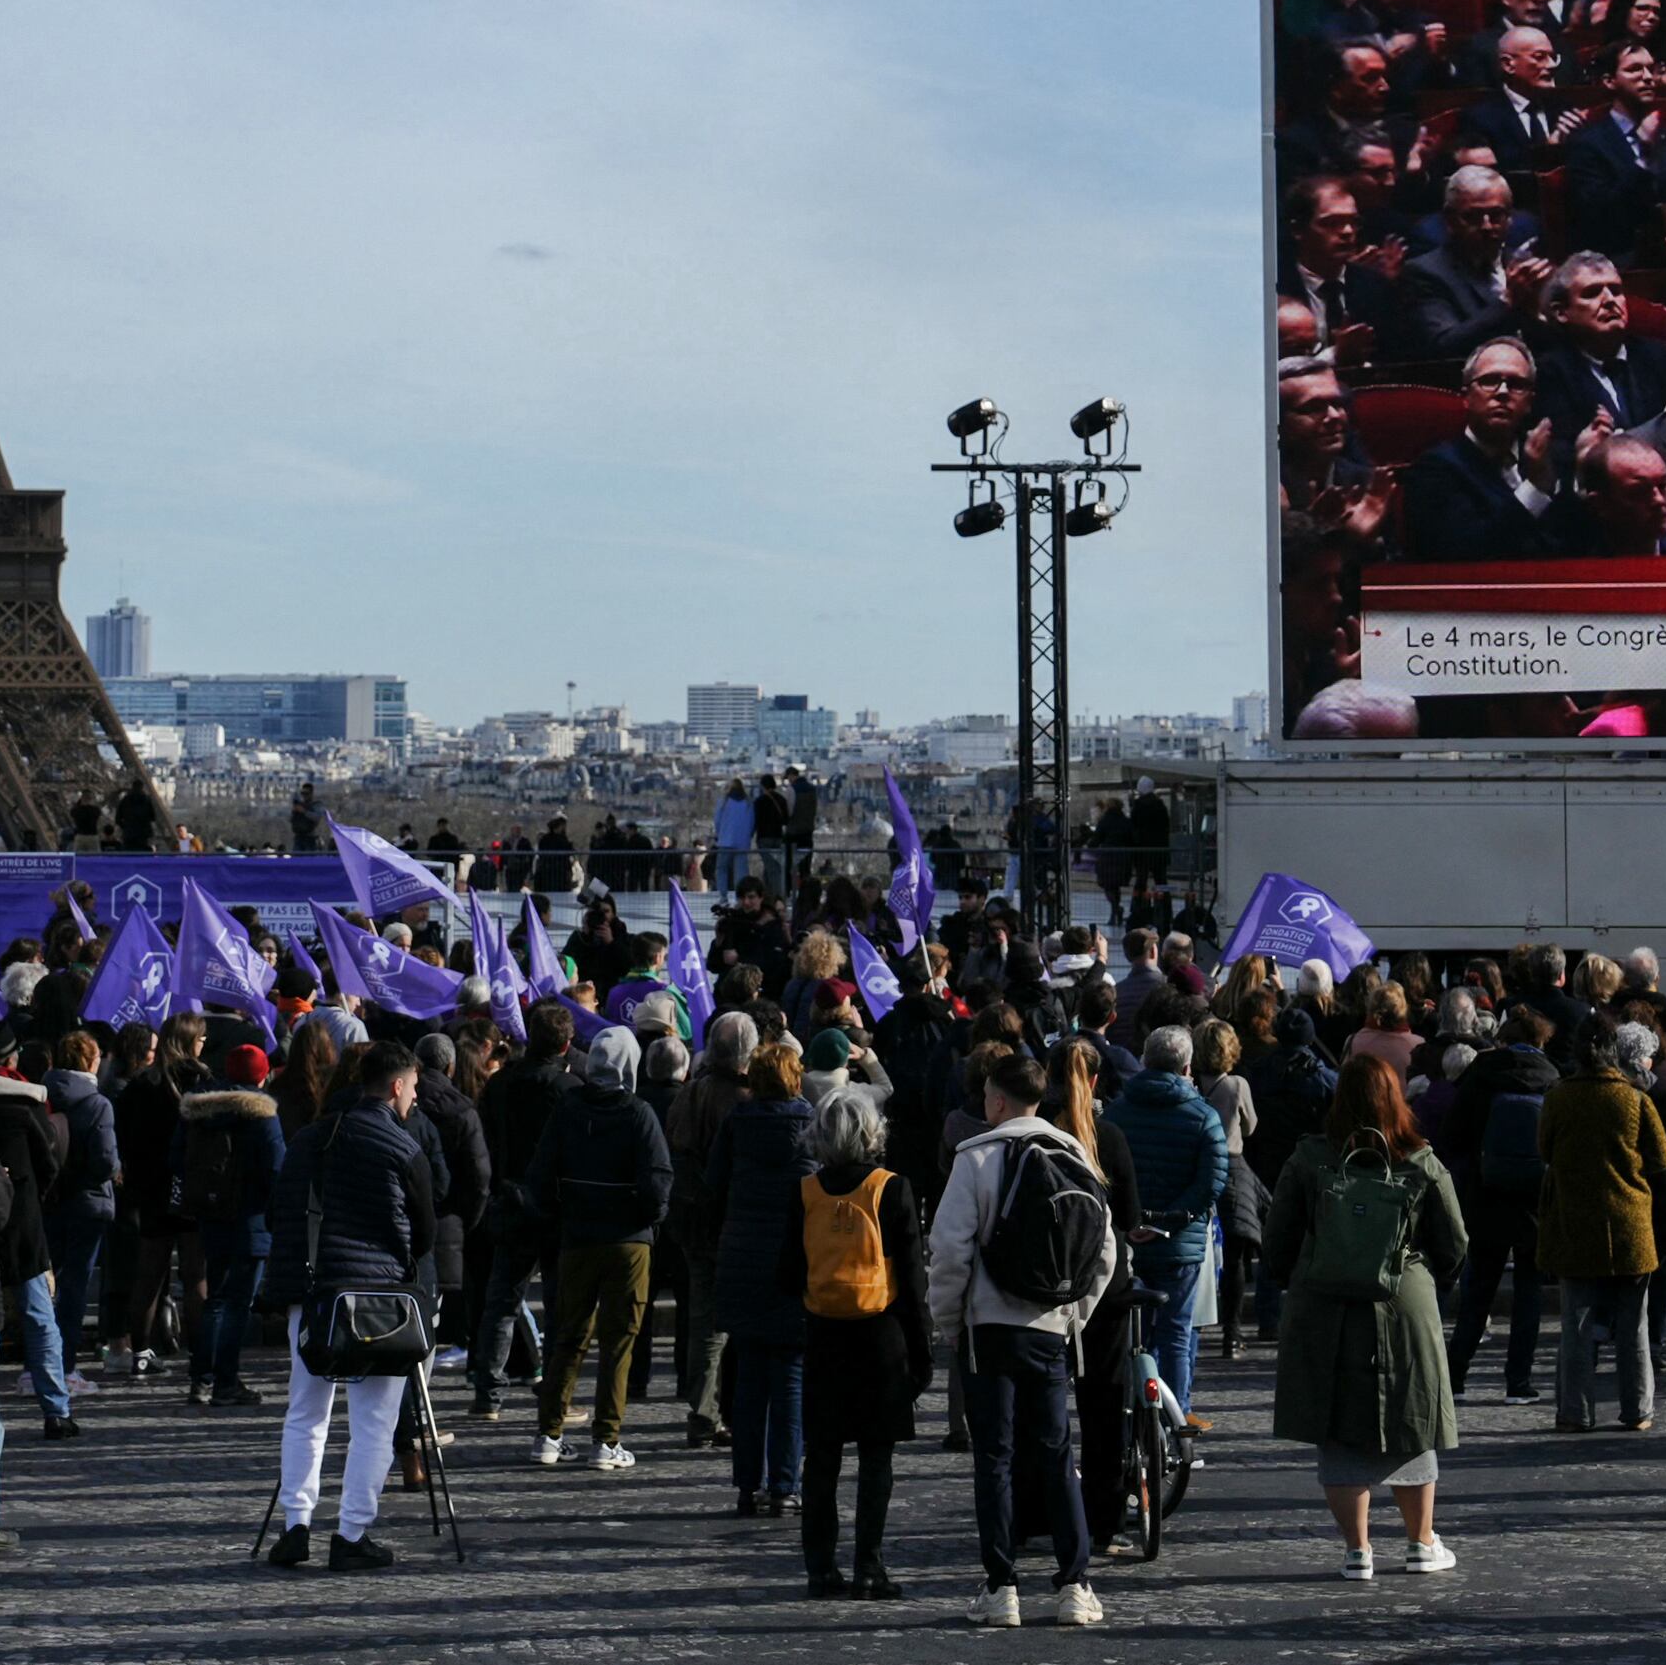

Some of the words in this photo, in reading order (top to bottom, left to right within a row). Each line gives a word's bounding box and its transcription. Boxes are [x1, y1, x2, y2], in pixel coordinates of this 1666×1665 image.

[1406, 626, 1435, 647] Le
[1445, 626, 1459, 647] 4
[1470, 632, 1536, 650] mars,
[1546, 625, 1567, 646] le
[1406, 654, 1568, 677] Constitution.
[1261, 927, 1314, 944] FONDATION
[1255, 939, 1270, 948] DES
[1272, 941, 1307, 955] FEMMES
